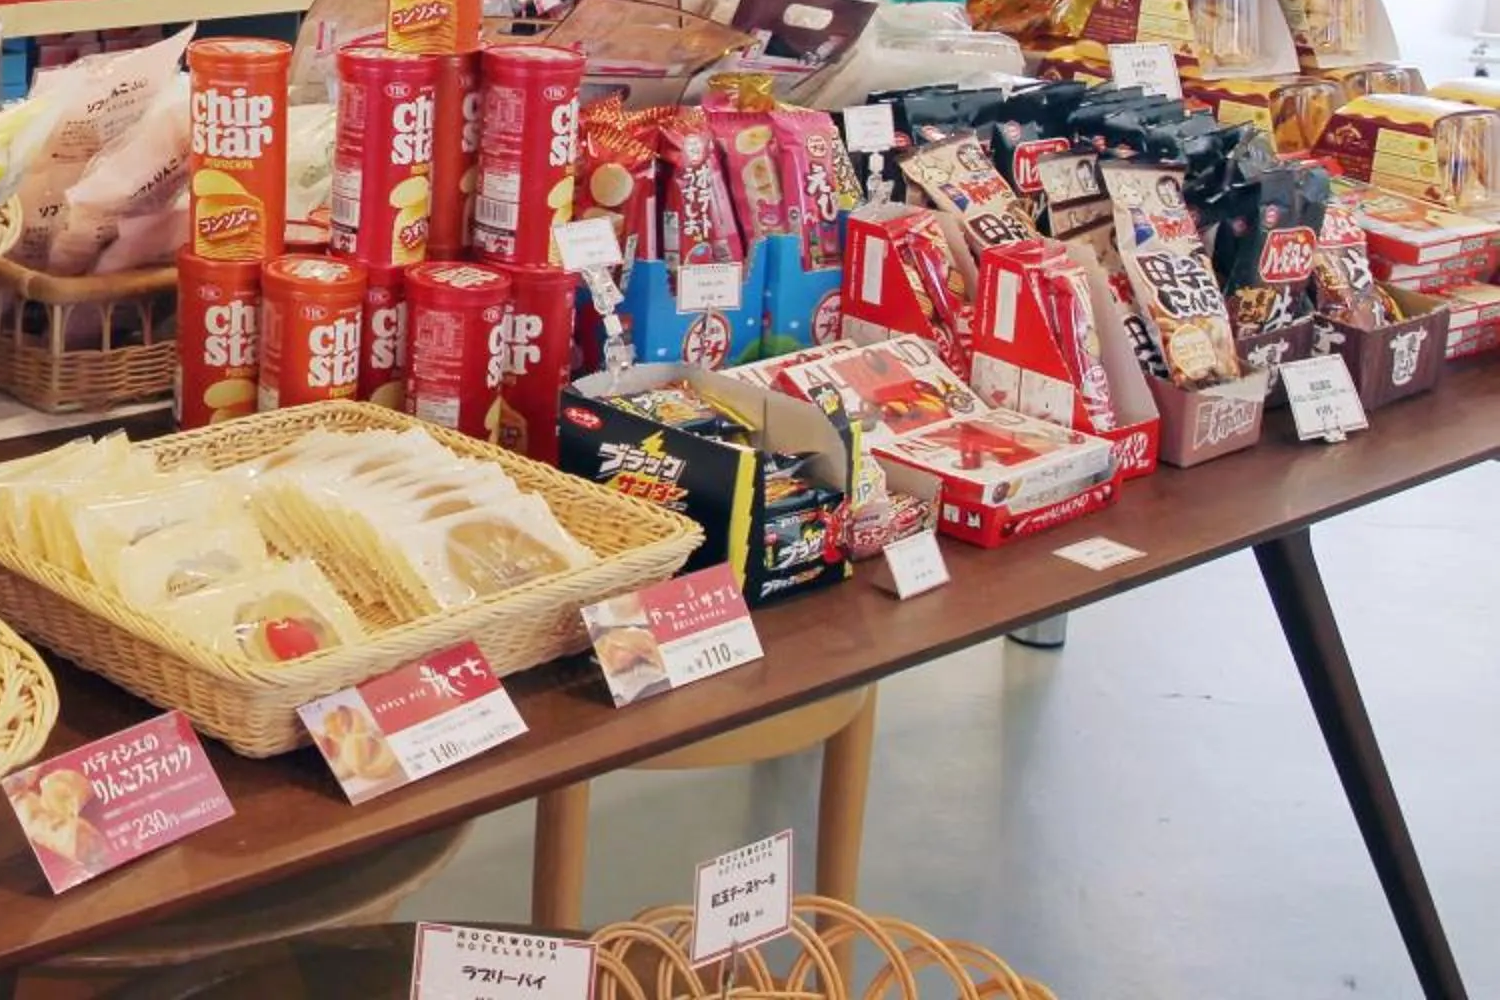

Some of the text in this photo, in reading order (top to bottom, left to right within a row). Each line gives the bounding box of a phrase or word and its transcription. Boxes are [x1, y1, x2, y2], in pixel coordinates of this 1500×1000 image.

[596, 443, 687, 481] ブラック
[81, 733, 159, 776] パティシエの
[92, 744, 192, 804] りんごスティック
[457, 930, 557, 951] ROCKWOOD
[461, 964, 547, 991] ラブリーパイ
